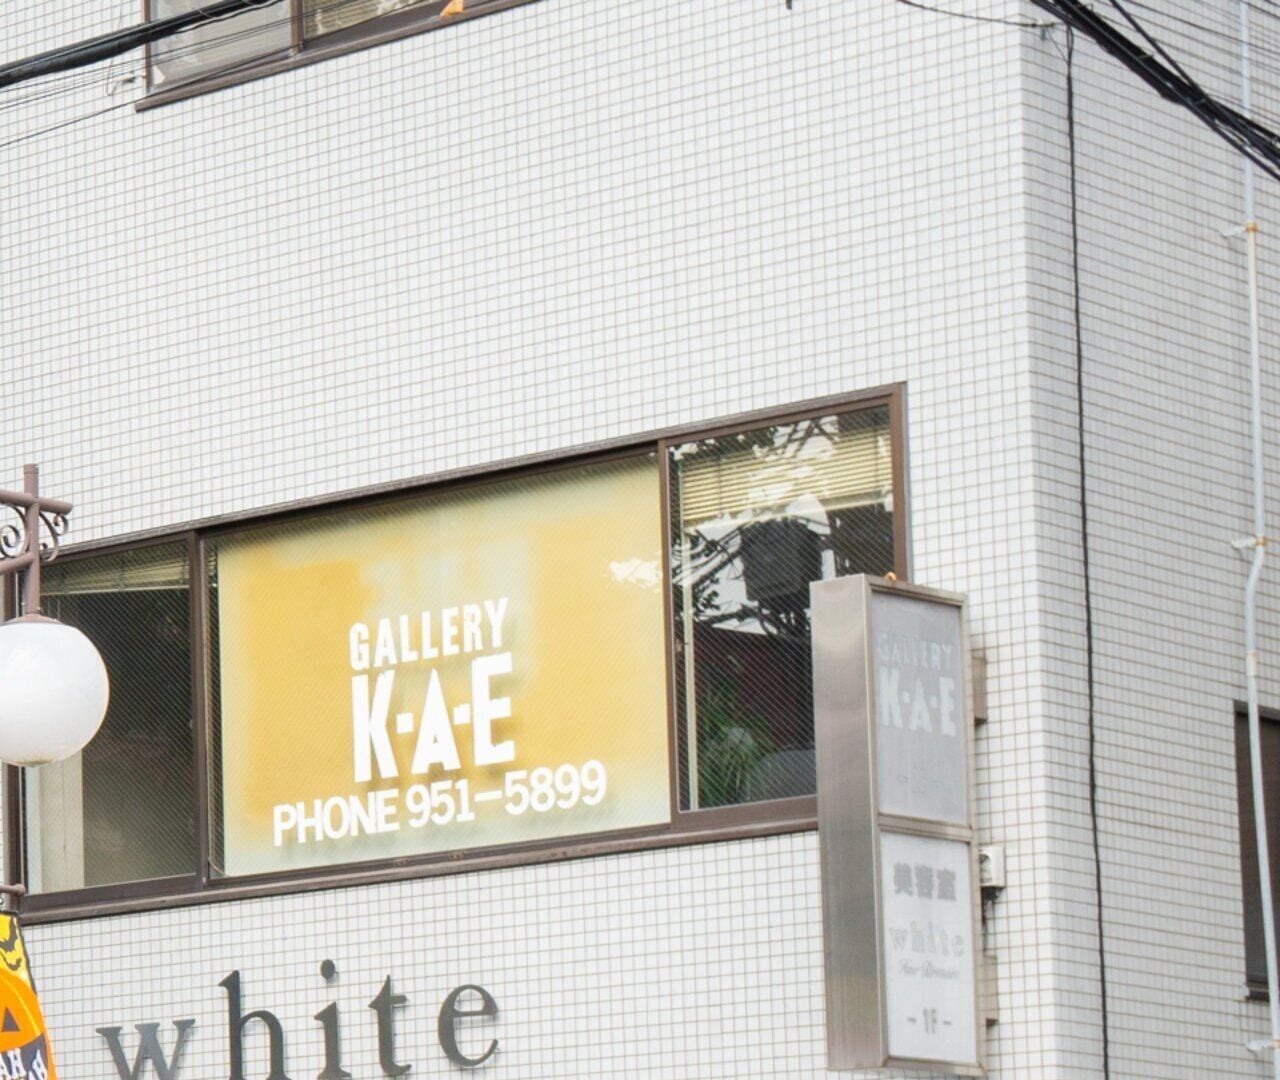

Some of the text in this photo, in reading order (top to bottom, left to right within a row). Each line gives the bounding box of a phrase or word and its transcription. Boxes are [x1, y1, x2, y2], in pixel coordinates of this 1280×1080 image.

[349, 597, 508, 670] GALLERY
[273, 759, 608, 847] PHONE 951-5899
[890, 920, 964, 957] white
